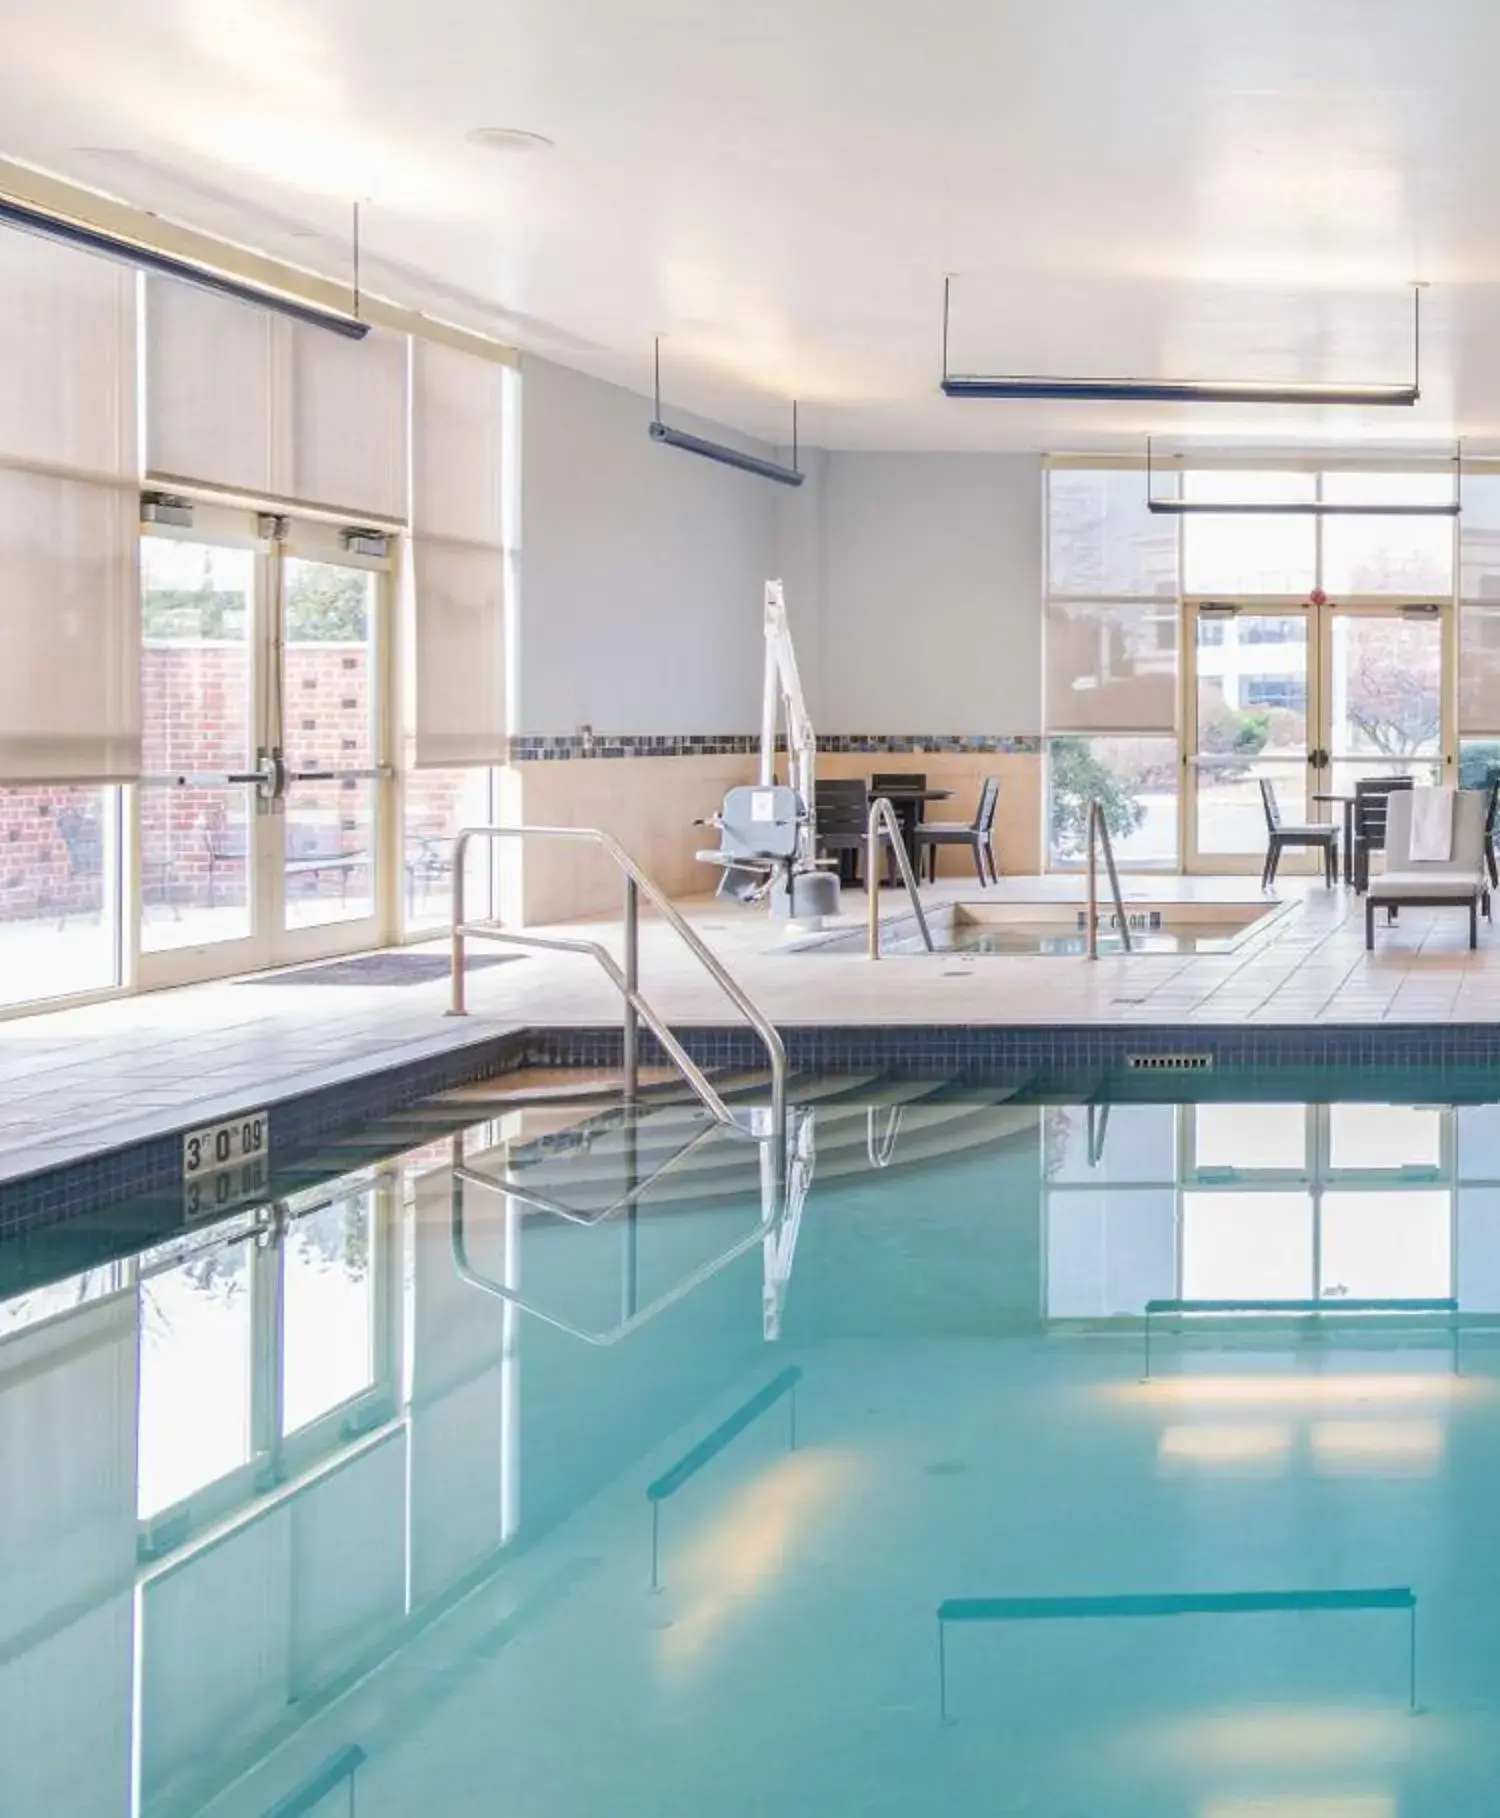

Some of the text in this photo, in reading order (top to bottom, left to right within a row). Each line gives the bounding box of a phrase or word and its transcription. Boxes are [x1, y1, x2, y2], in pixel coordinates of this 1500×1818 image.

[187, 1138, 201, 1170] 3
[217, 1129, 230, 1162] 0
[243, 1119, 262, 1154] 09
